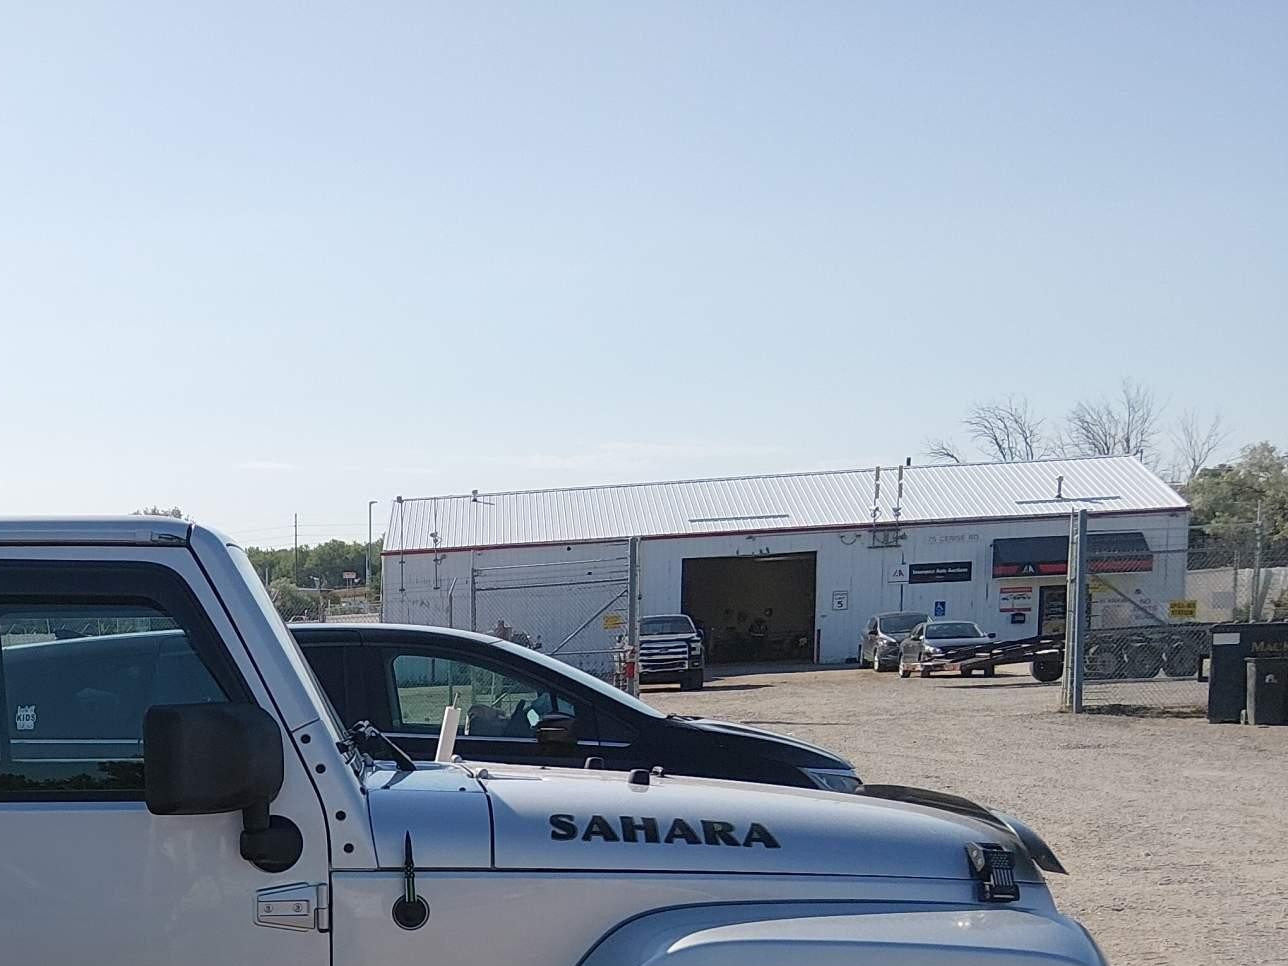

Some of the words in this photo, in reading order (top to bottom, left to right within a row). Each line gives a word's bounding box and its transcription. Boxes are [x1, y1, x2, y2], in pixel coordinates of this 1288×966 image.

[837, 600, 843, 608] 5
[17, 714, 35, 722] KIDS
[548, 813, 782, 849] SAHARA
